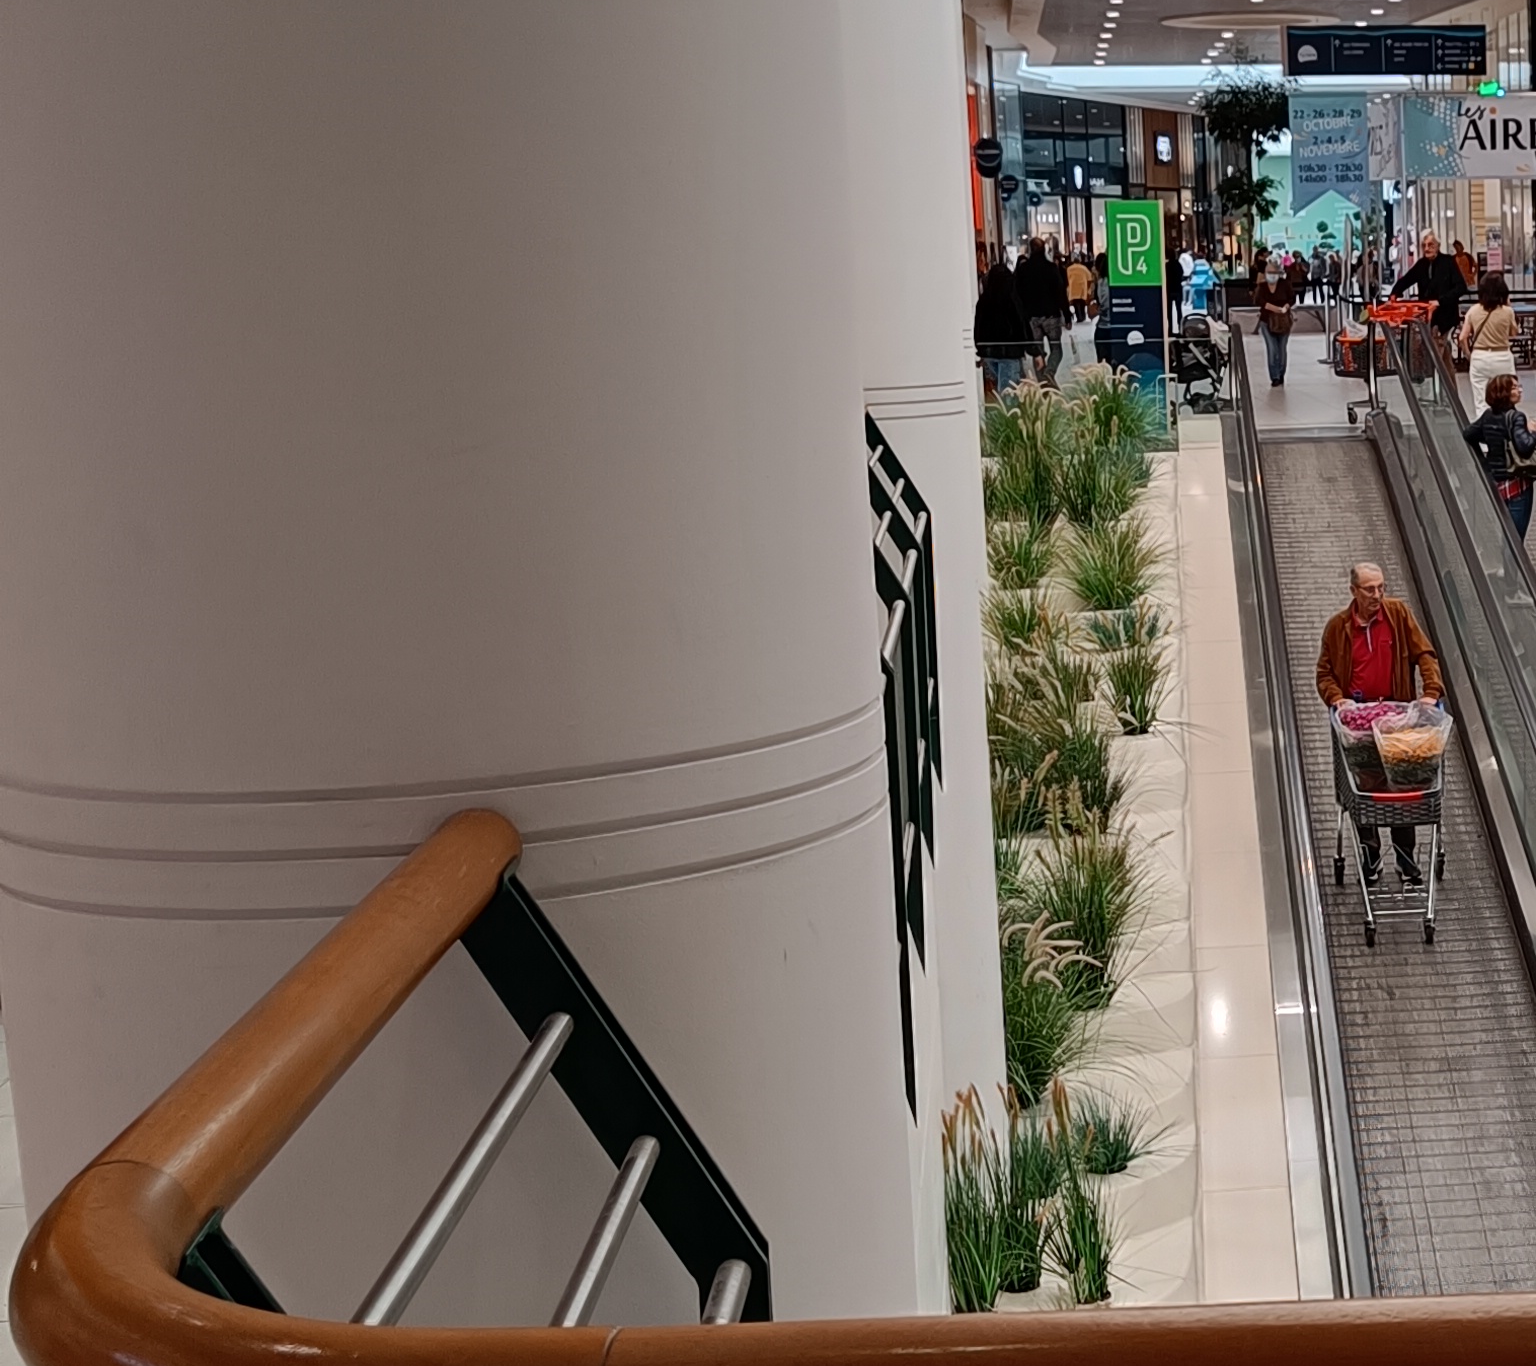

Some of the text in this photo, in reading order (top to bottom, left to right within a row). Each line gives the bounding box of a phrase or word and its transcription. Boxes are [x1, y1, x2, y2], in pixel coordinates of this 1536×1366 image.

[1457, 101, 1487, 120] Les
[1303, 117, 1354, 132] OCTOBRE
[1300, 140, 1360, 158] NOVEMBRE
[1298, 163, 1327, 173] 10h30
[1334, 163, 1363, 173] 12h30
[1298, 174, 1327, 183] 14h00
[1336, 173, 1364, 183] 18h30
